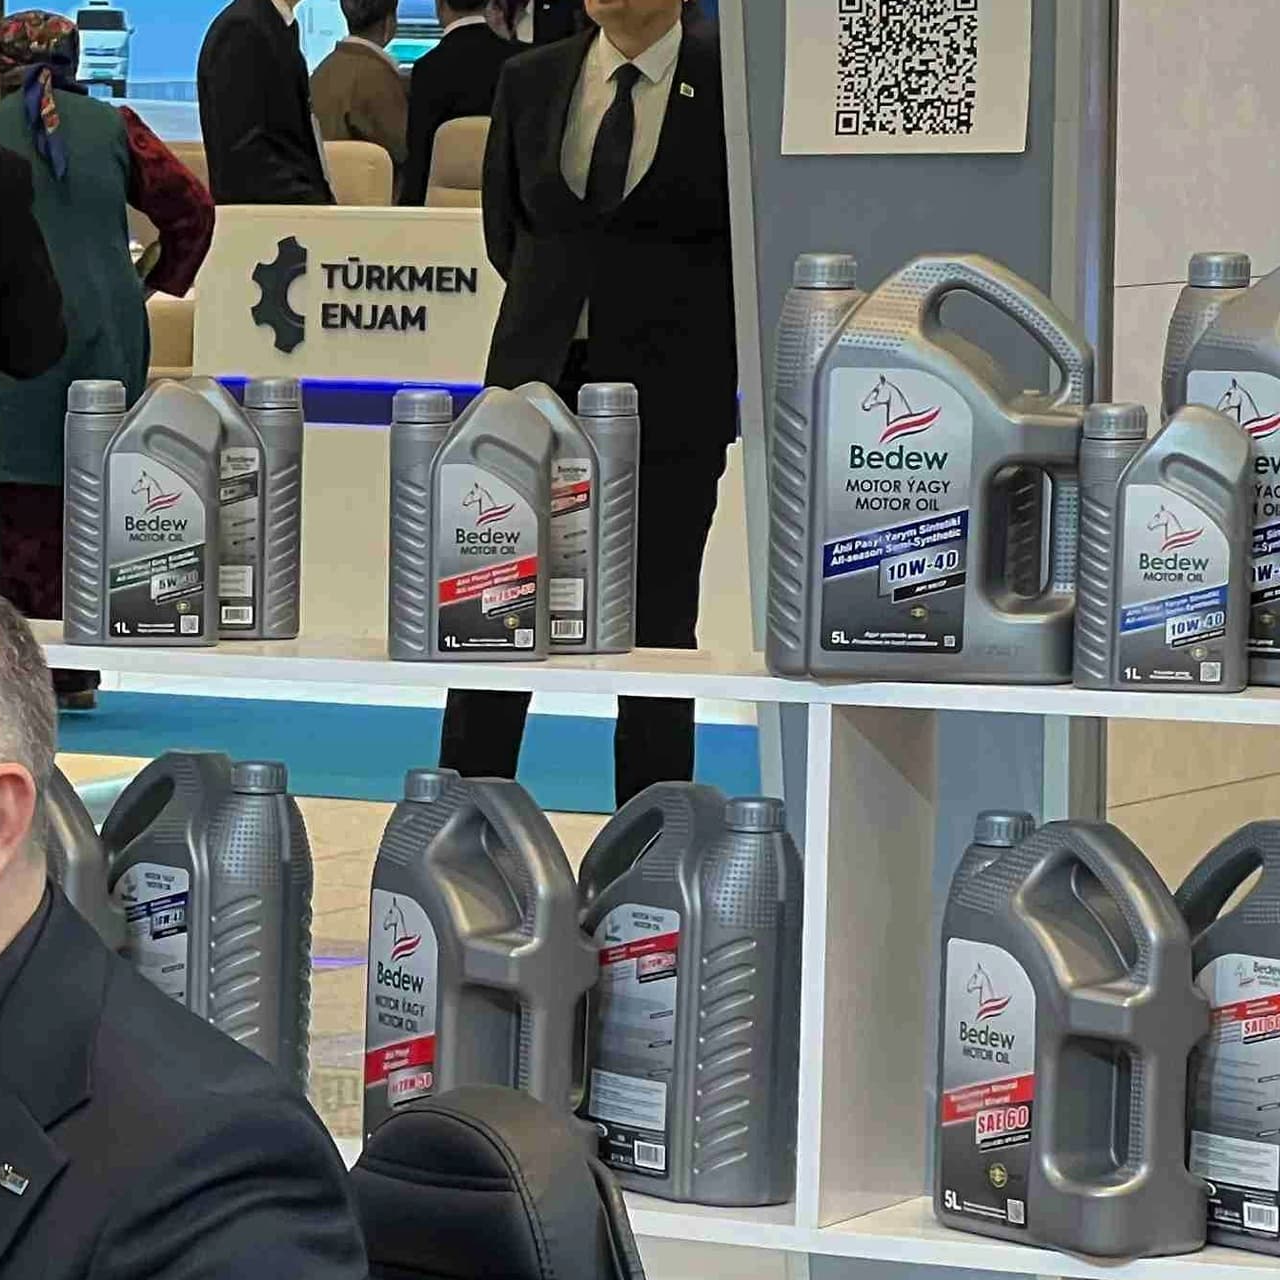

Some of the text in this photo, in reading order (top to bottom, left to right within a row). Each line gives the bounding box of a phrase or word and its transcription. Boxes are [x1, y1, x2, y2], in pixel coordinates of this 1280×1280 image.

[320, 256, 478, 293] TÜRKMEN
[320, 303, 427, 332] ENJAM
[850, 444, 949, 470] Bedew
[846, 475, 951, 494] MOTOR ÝAGY
[855, 497, 940, 511] MOTOR OIL
[124, 515, 188, 532] Bedew
[129, 533, 165, 542] MOTOR
[455, 528, 520, 544] Bedew
[461, 545, 497, 555] MOTOR
[887, 550, 959, 583] 10W-40
[1139, 552, 1209, 572] Bedew
[1143, 572, 1204, 583] MOTOR OIL
[114, 622, 131, 634] 1L
[1171, 611, 1225, 637] 10W-40
[444, 636, 460, 648] 1L
[831, 631, 850, 644] 5L
[1124, 667, 1142, 680] 1L
[376, 960, 424, 994] Bedew
[959, 1021, 1016, 1050] Bedew
[962, 1047, 1011, 1065] MOTOR OIL
[978, 1106, 1030, 1134] SAE 60
[944, 1189, 962, 1211] 5L
